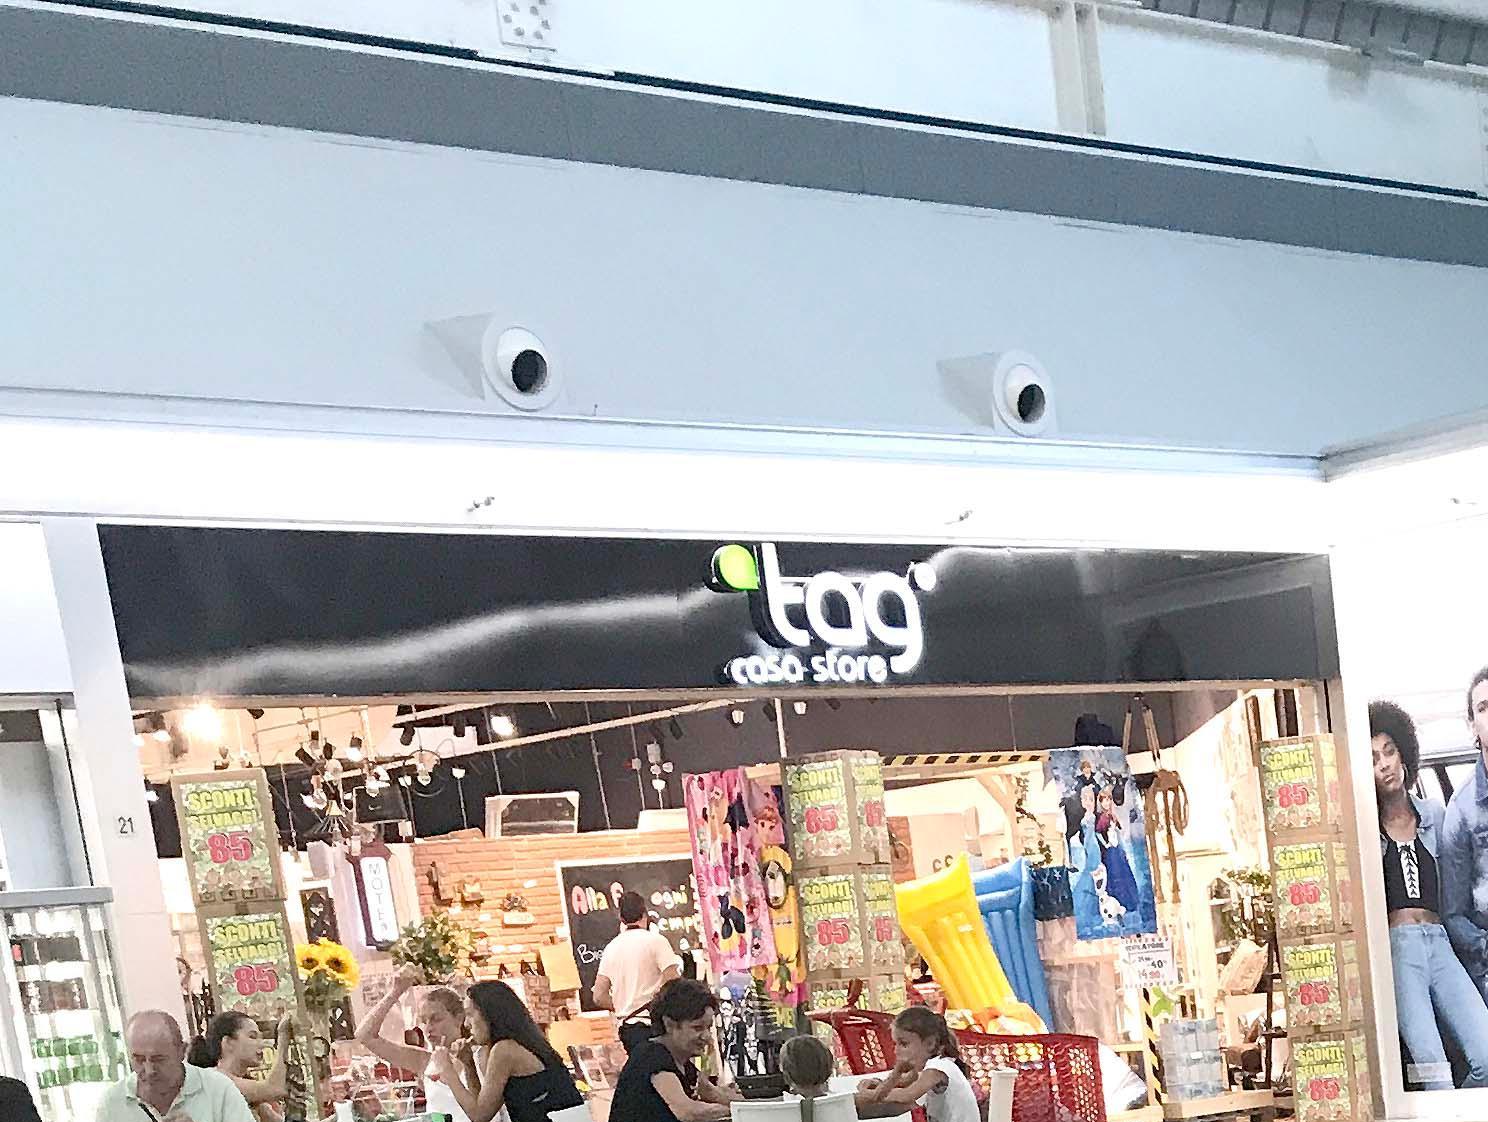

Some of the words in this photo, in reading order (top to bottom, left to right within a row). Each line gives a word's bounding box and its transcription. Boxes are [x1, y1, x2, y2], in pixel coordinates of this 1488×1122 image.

[760, 542, 937, 674] tag
[727, 654, 804, 684] casa
[811, 648, 888, 683] store
[187, 788, 254, 812] SCONTI
[118, 816, 135, 835] 21
[651, 884, 688, 910] ogni
[804, 880, 851, 902] SCONTI
[214, 920, 277, 944] SCONTI
